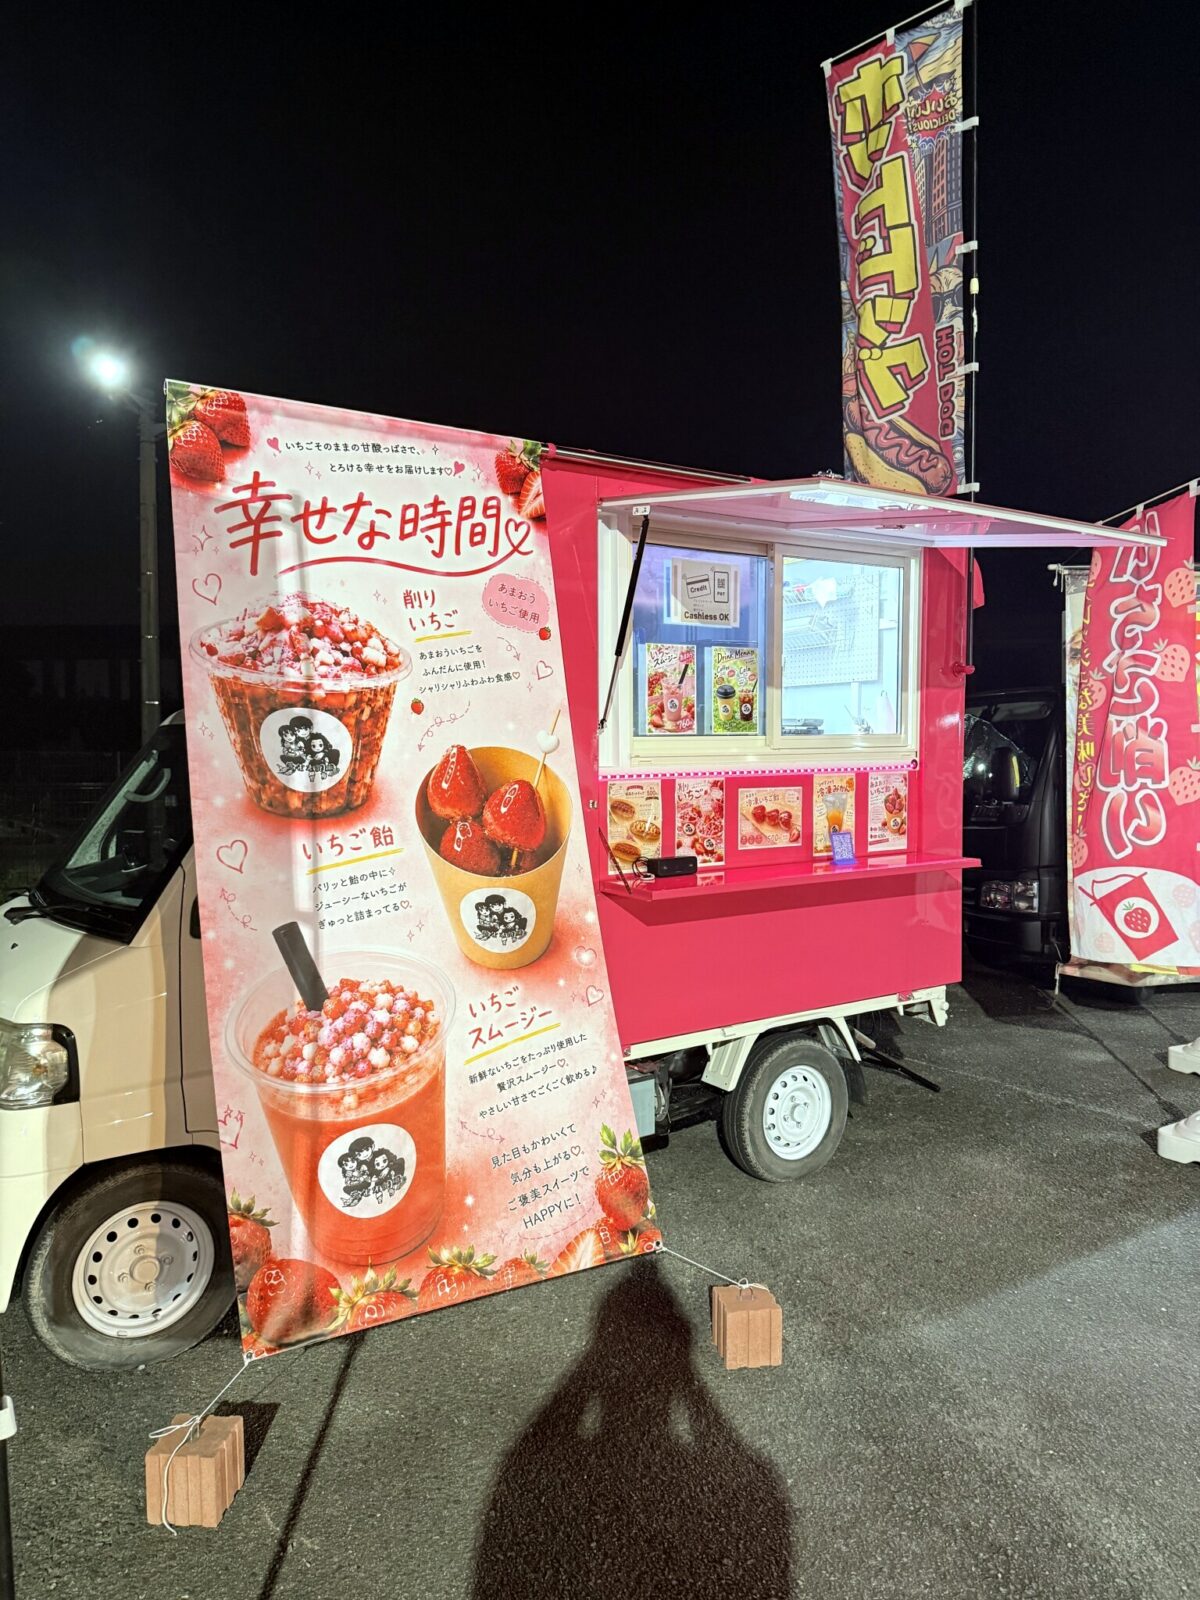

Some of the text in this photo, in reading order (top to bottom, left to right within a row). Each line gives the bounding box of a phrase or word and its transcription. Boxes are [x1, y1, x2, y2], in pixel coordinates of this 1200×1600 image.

[214, 471, 500, 577] 幸せな時間
[402, 588, 436, 610] 削り
[497, 582, 537, 604] あまおう
[690, 584, 708, 594] Credit
[409, 609, 459, 632] いちご
[488, 599, 541, 624] いちご使用
[684, 611, 730, 622] Cashless OK
[418, 644, 483, 661] あまおういちごを
[677, 788, 704, 802] いちご
[302, 825, 395, 860] いちご飴
[314, 881, 408, 912] ジューシーないちごが
[318, 903, 400, 929] ぎゅっと詰まってる
[468, 985, 520, 1018] いちご
[468, 1006, 553, 1050] スムージー
[468, 1033, 588, 1085] 新鮮ないちごをたっぷり使用した
[491, 1123, 578, 1169] 見た目もかわいくて
[508, 1166, 591, 1212] ご褒美スイーツで
